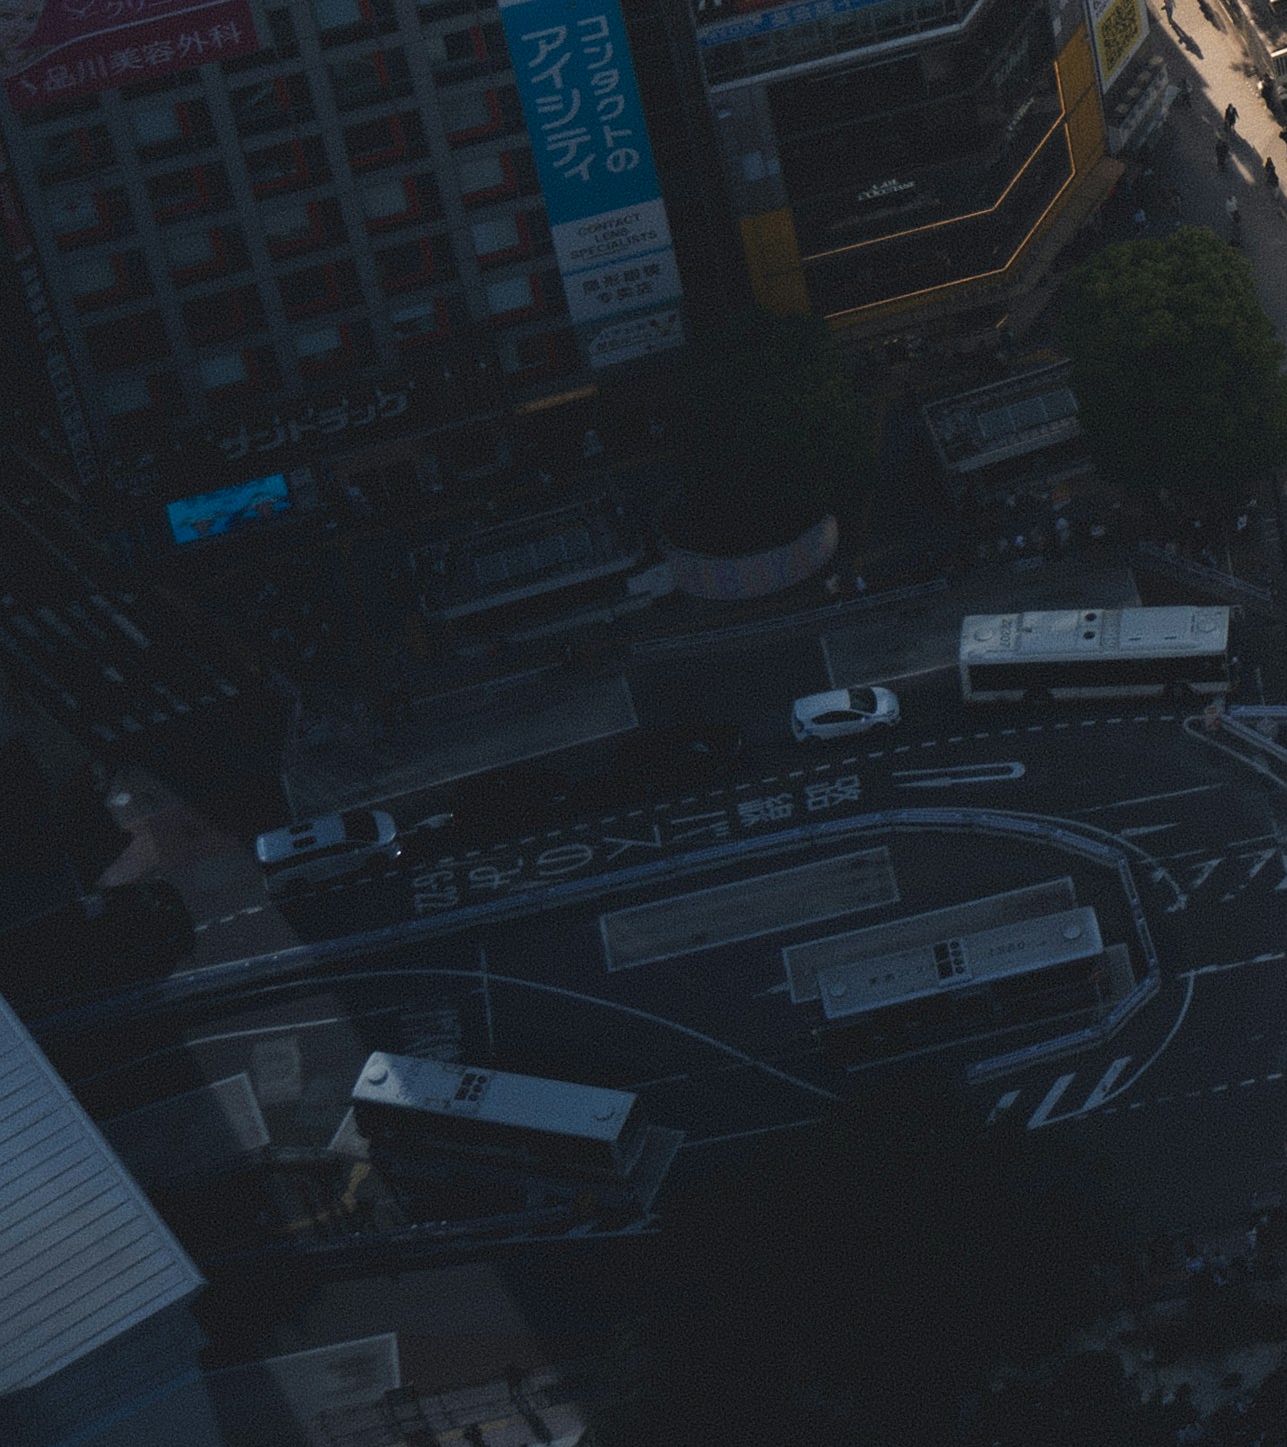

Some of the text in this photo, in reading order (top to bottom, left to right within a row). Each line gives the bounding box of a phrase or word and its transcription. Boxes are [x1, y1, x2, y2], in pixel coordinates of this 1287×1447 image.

[520, 24, 599, 182] アイシティ
[577, 14, 641, 175] コンタクトの
[577, 212, 642, 237] CONTACT
